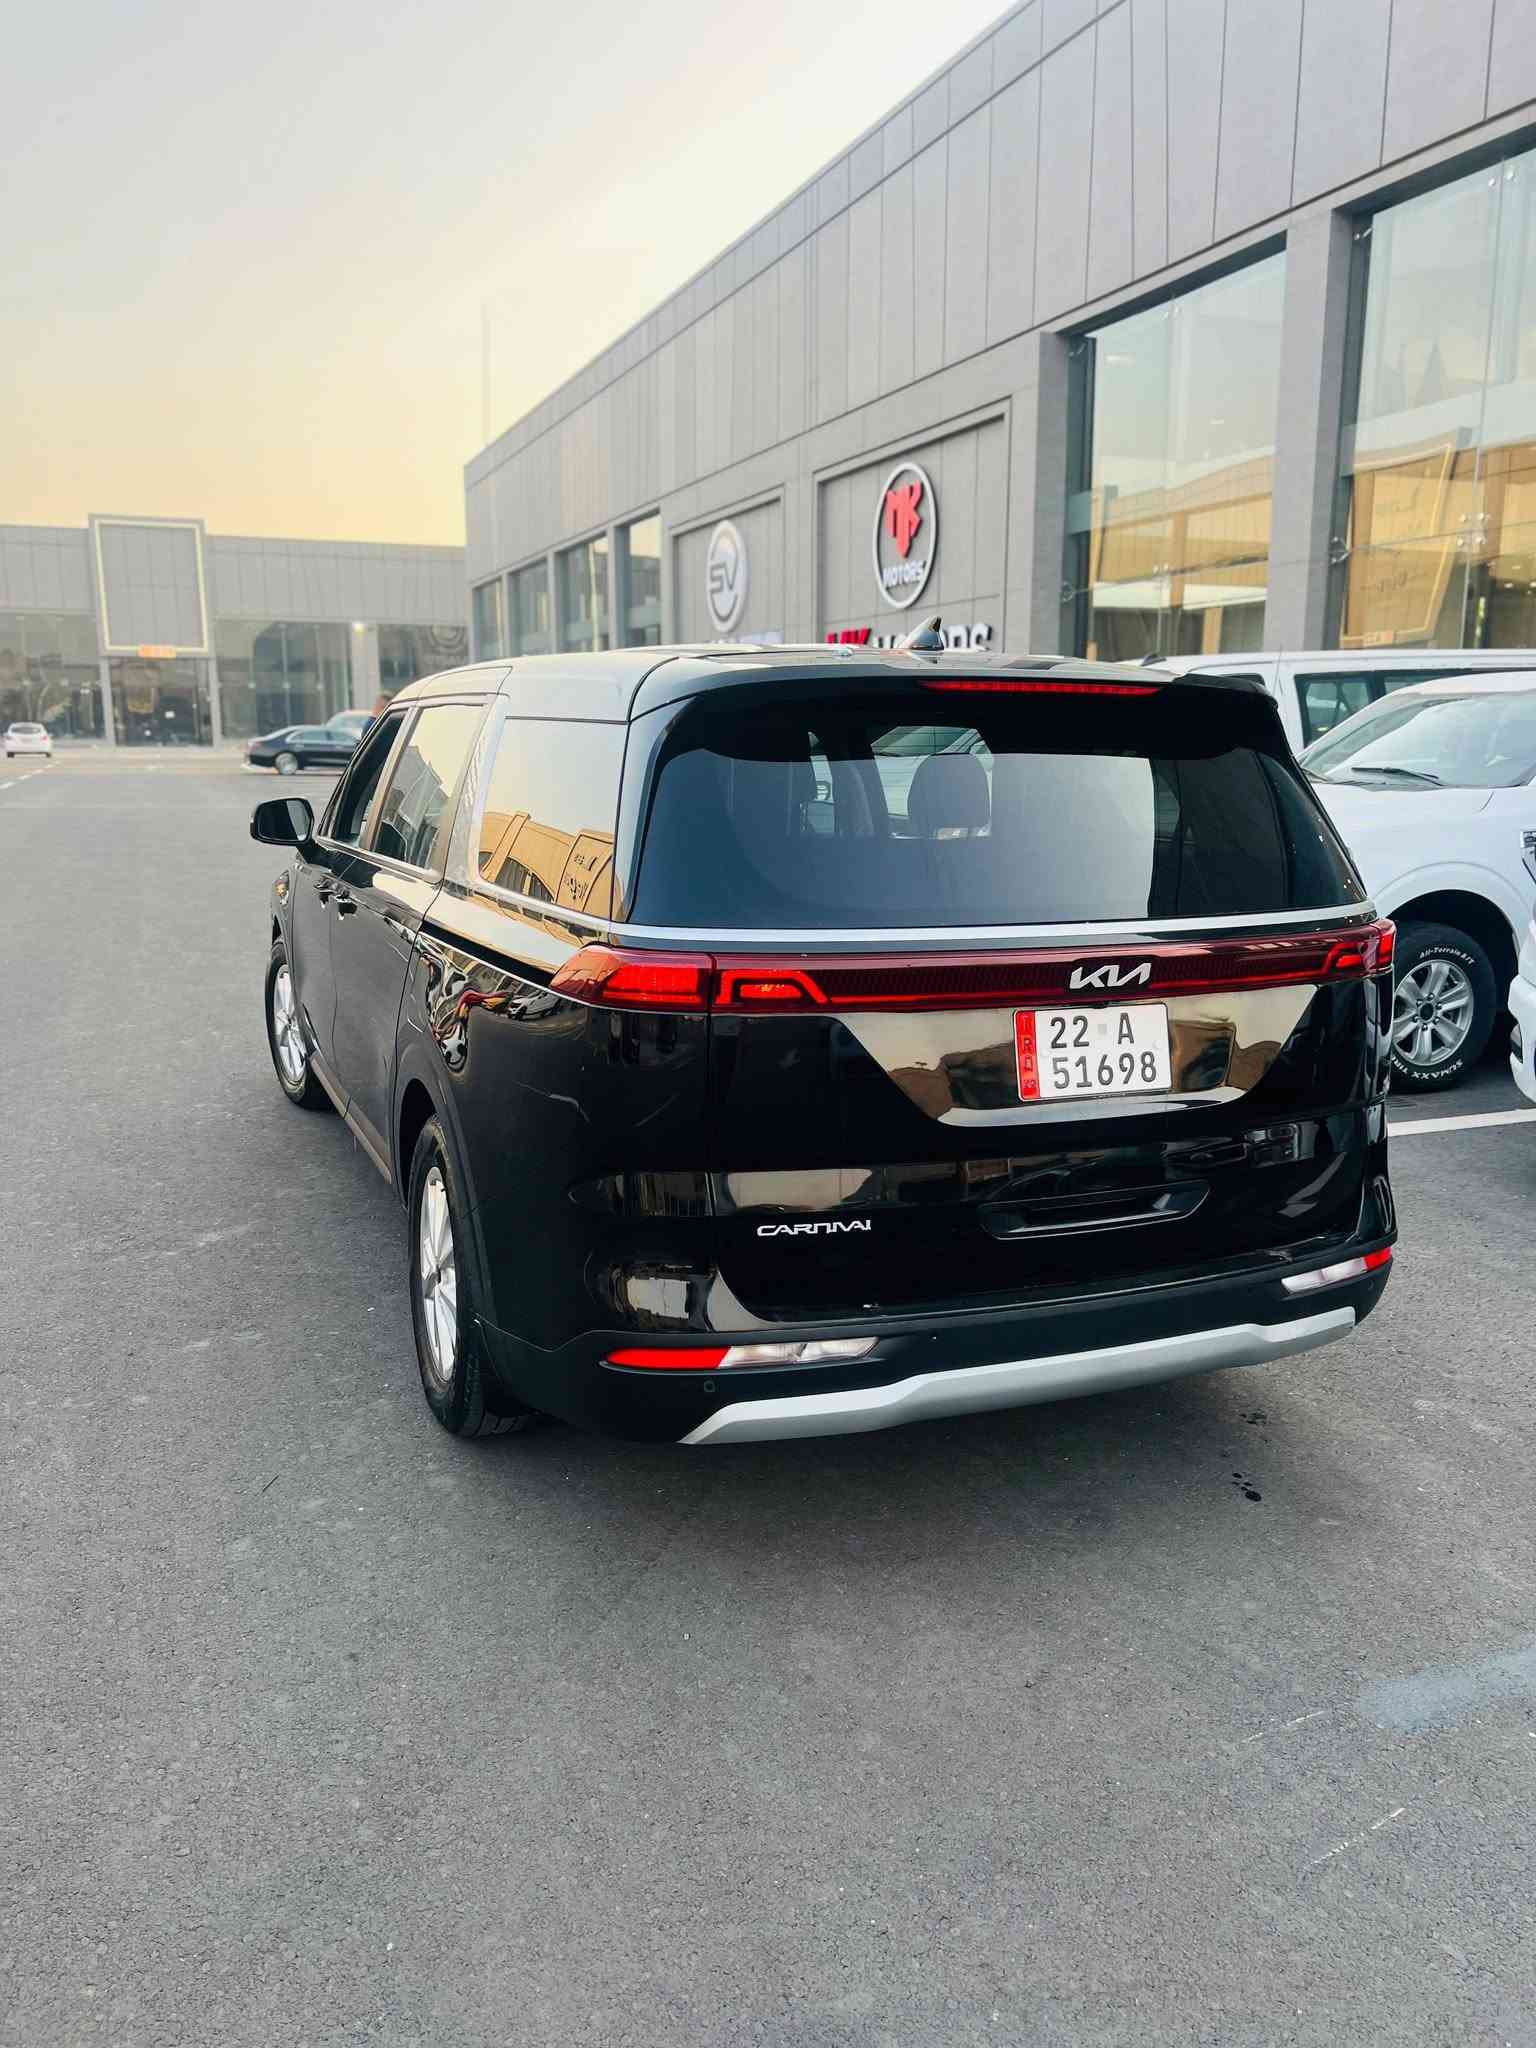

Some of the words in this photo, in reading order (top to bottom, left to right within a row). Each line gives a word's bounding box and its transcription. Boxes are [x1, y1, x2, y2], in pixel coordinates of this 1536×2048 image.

[882, 560, 926, 589] MOTORS
[1069, 962, 1152, 990] KIA
[1050, 1015, 1090, 1049] 22
[1117, 1012, 1135, 1045] A
[1052, 1051, 1157, 1090] 51698
